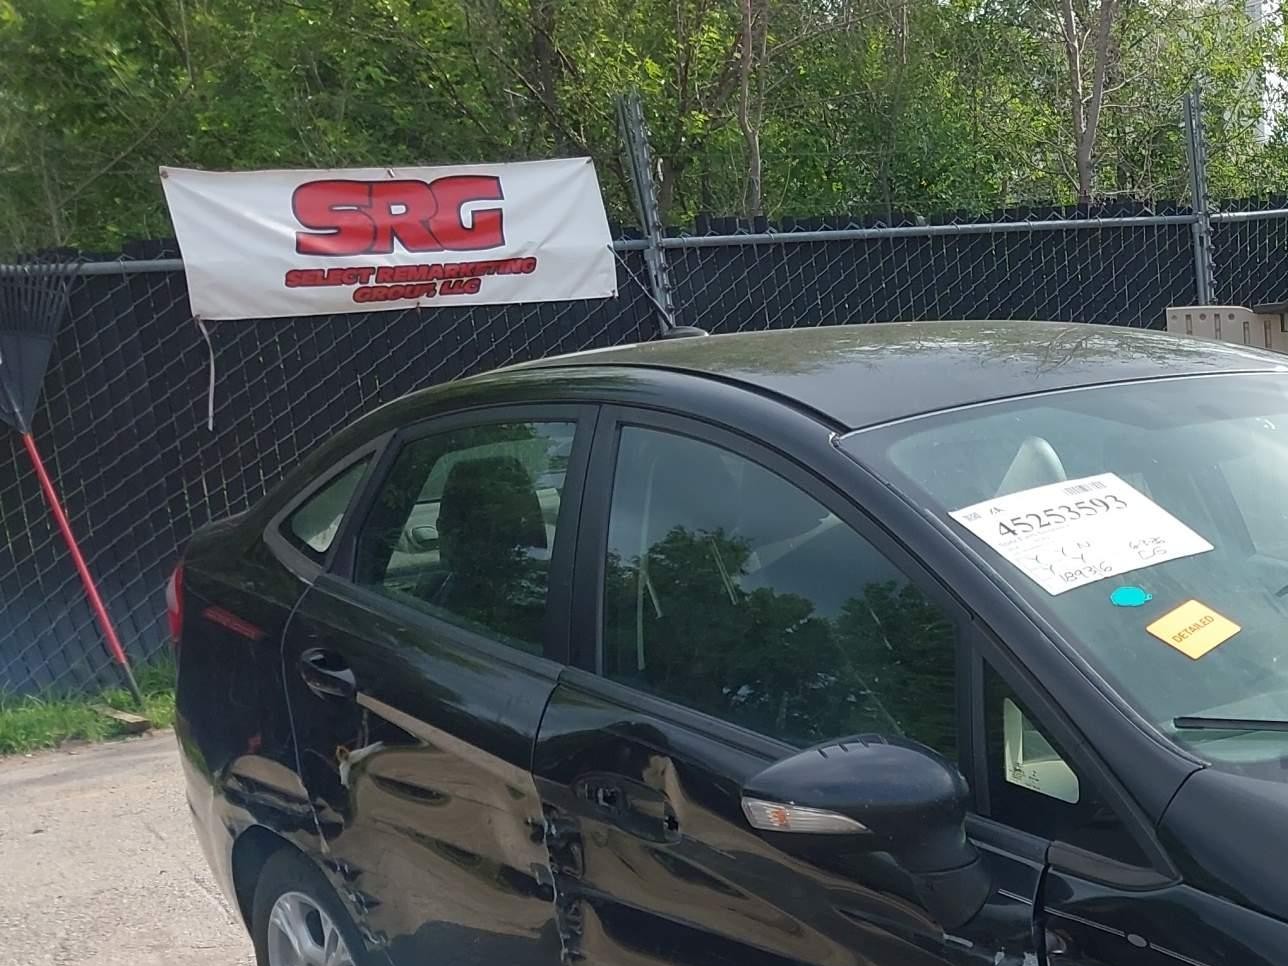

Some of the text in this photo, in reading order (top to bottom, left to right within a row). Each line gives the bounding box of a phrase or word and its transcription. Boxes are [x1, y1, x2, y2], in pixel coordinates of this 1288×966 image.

[291, 174, 506, 257] SRG
[285, 256, 538, 288] SELECT REMARKETING
[438, 278, 482, 295] LLC
[998, 494, 1129, 537] 45253593
[1171, 615, 1215, 644] DETAILED
